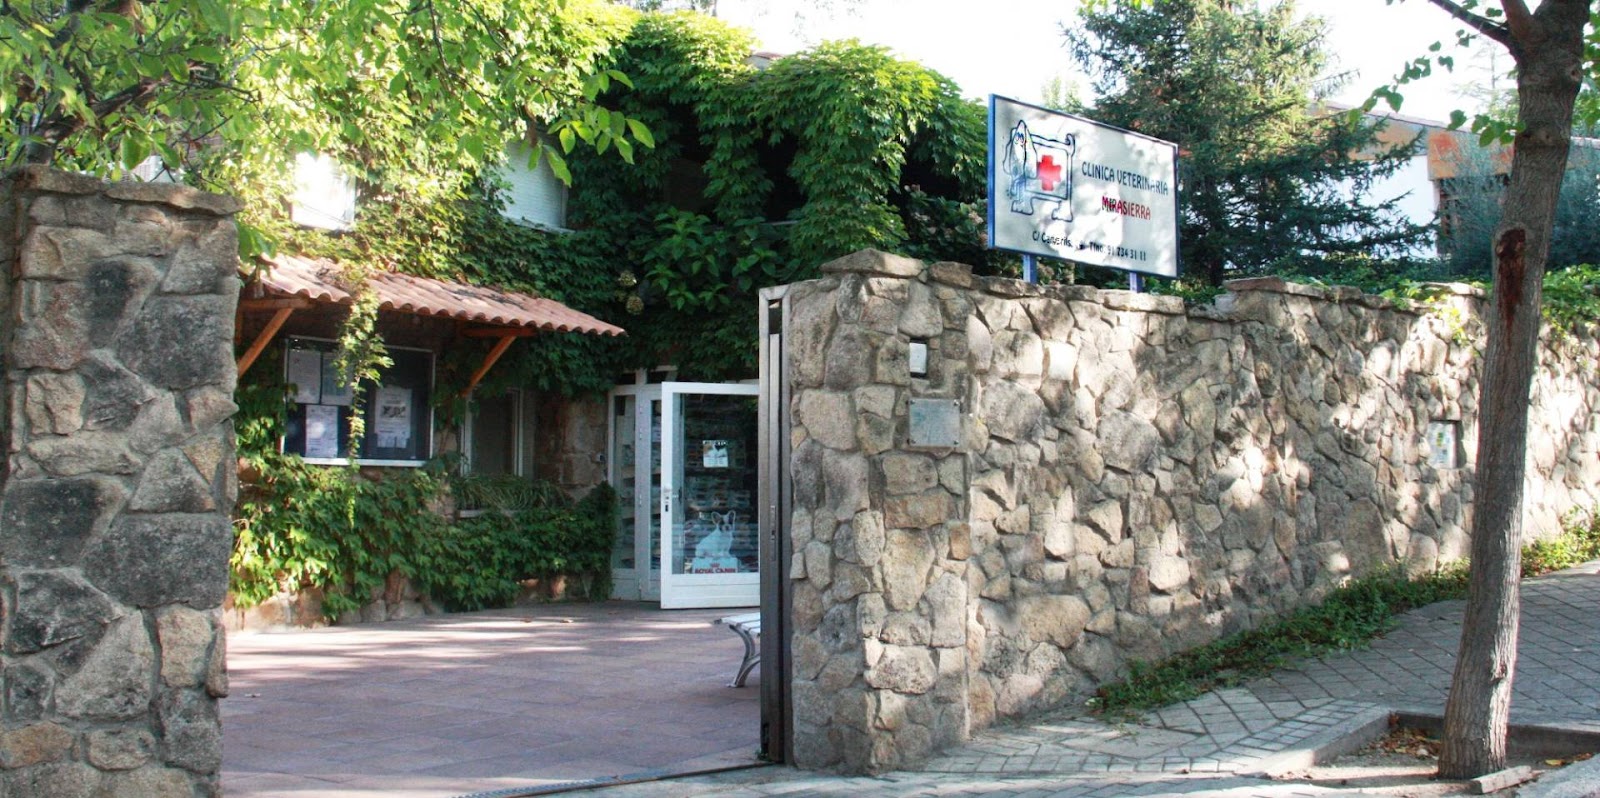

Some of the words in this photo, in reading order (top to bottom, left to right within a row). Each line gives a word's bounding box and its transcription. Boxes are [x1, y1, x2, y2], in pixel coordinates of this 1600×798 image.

[1081, 161, 1114, 181] CLINICA
[1117, 169, 1168, 194] VETERINARIA
[1101, 196, 1151, 219] MIRASIERRA
[1130, 249, 1138, 260] 31
[1139, 251, 1147, 261] 11
